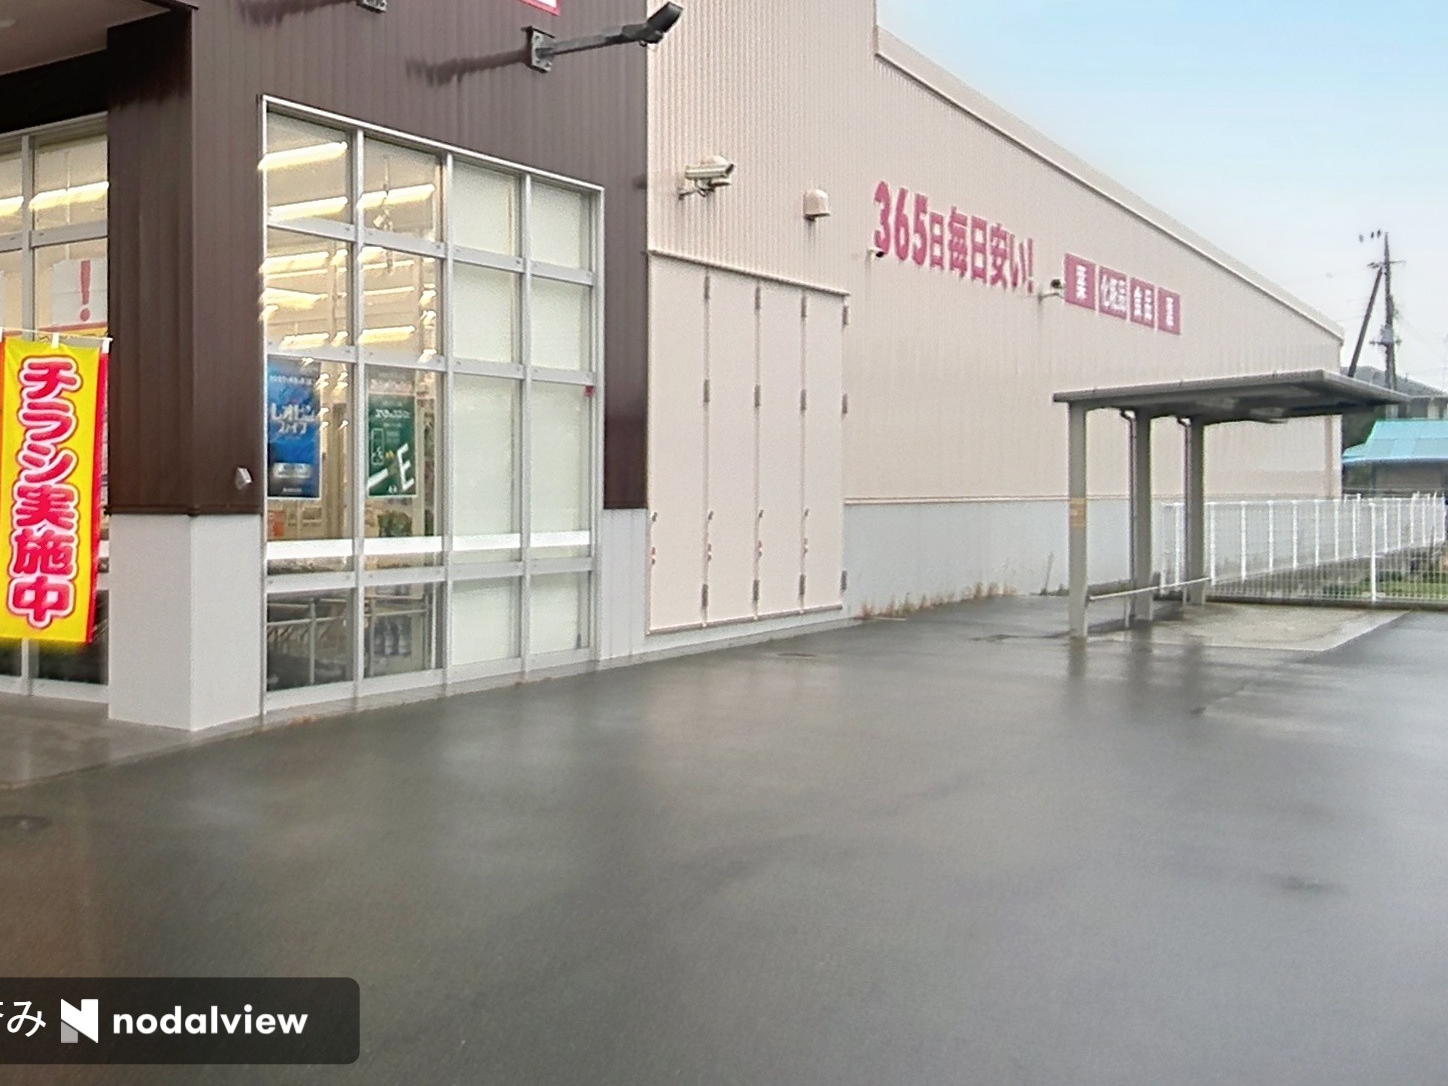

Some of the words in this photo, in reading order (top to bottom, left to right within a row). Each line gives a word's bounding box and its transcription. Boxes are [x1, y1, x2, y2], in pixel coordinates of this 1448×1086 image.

[7, 357, 84, 629] チラシ実施中
